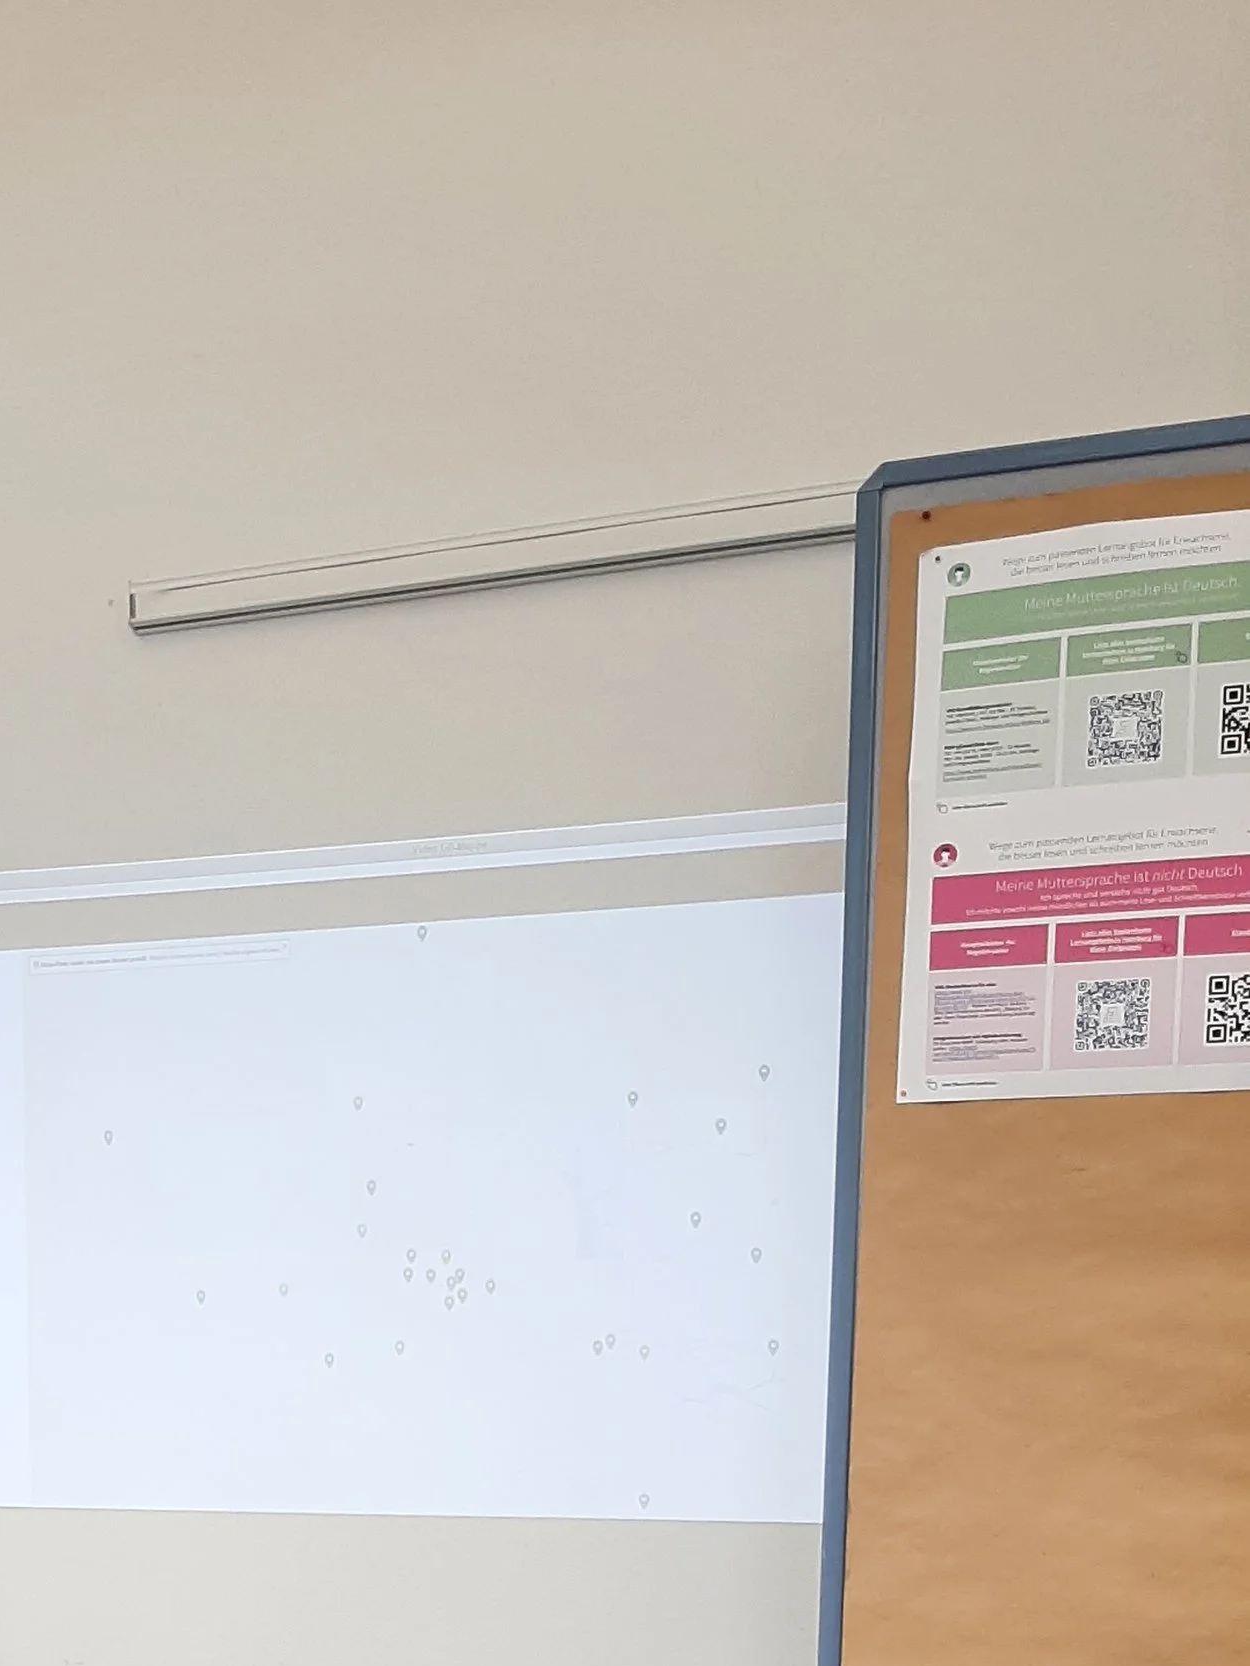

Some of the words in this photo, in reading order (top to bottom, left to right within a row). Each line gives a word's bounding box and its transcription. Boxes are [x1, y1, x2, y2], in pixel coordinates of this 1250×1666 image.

[1025, 595, 1063, 610] Meine
[995, 879, 1034, 893] Meine
[1037, 871, 1130, 890] Muttersprache
[1134, 869, 1149, 883] ist
[1152, 868, 1185, 881] nicht
[1188, 863, 1243, 879] Deutsch
